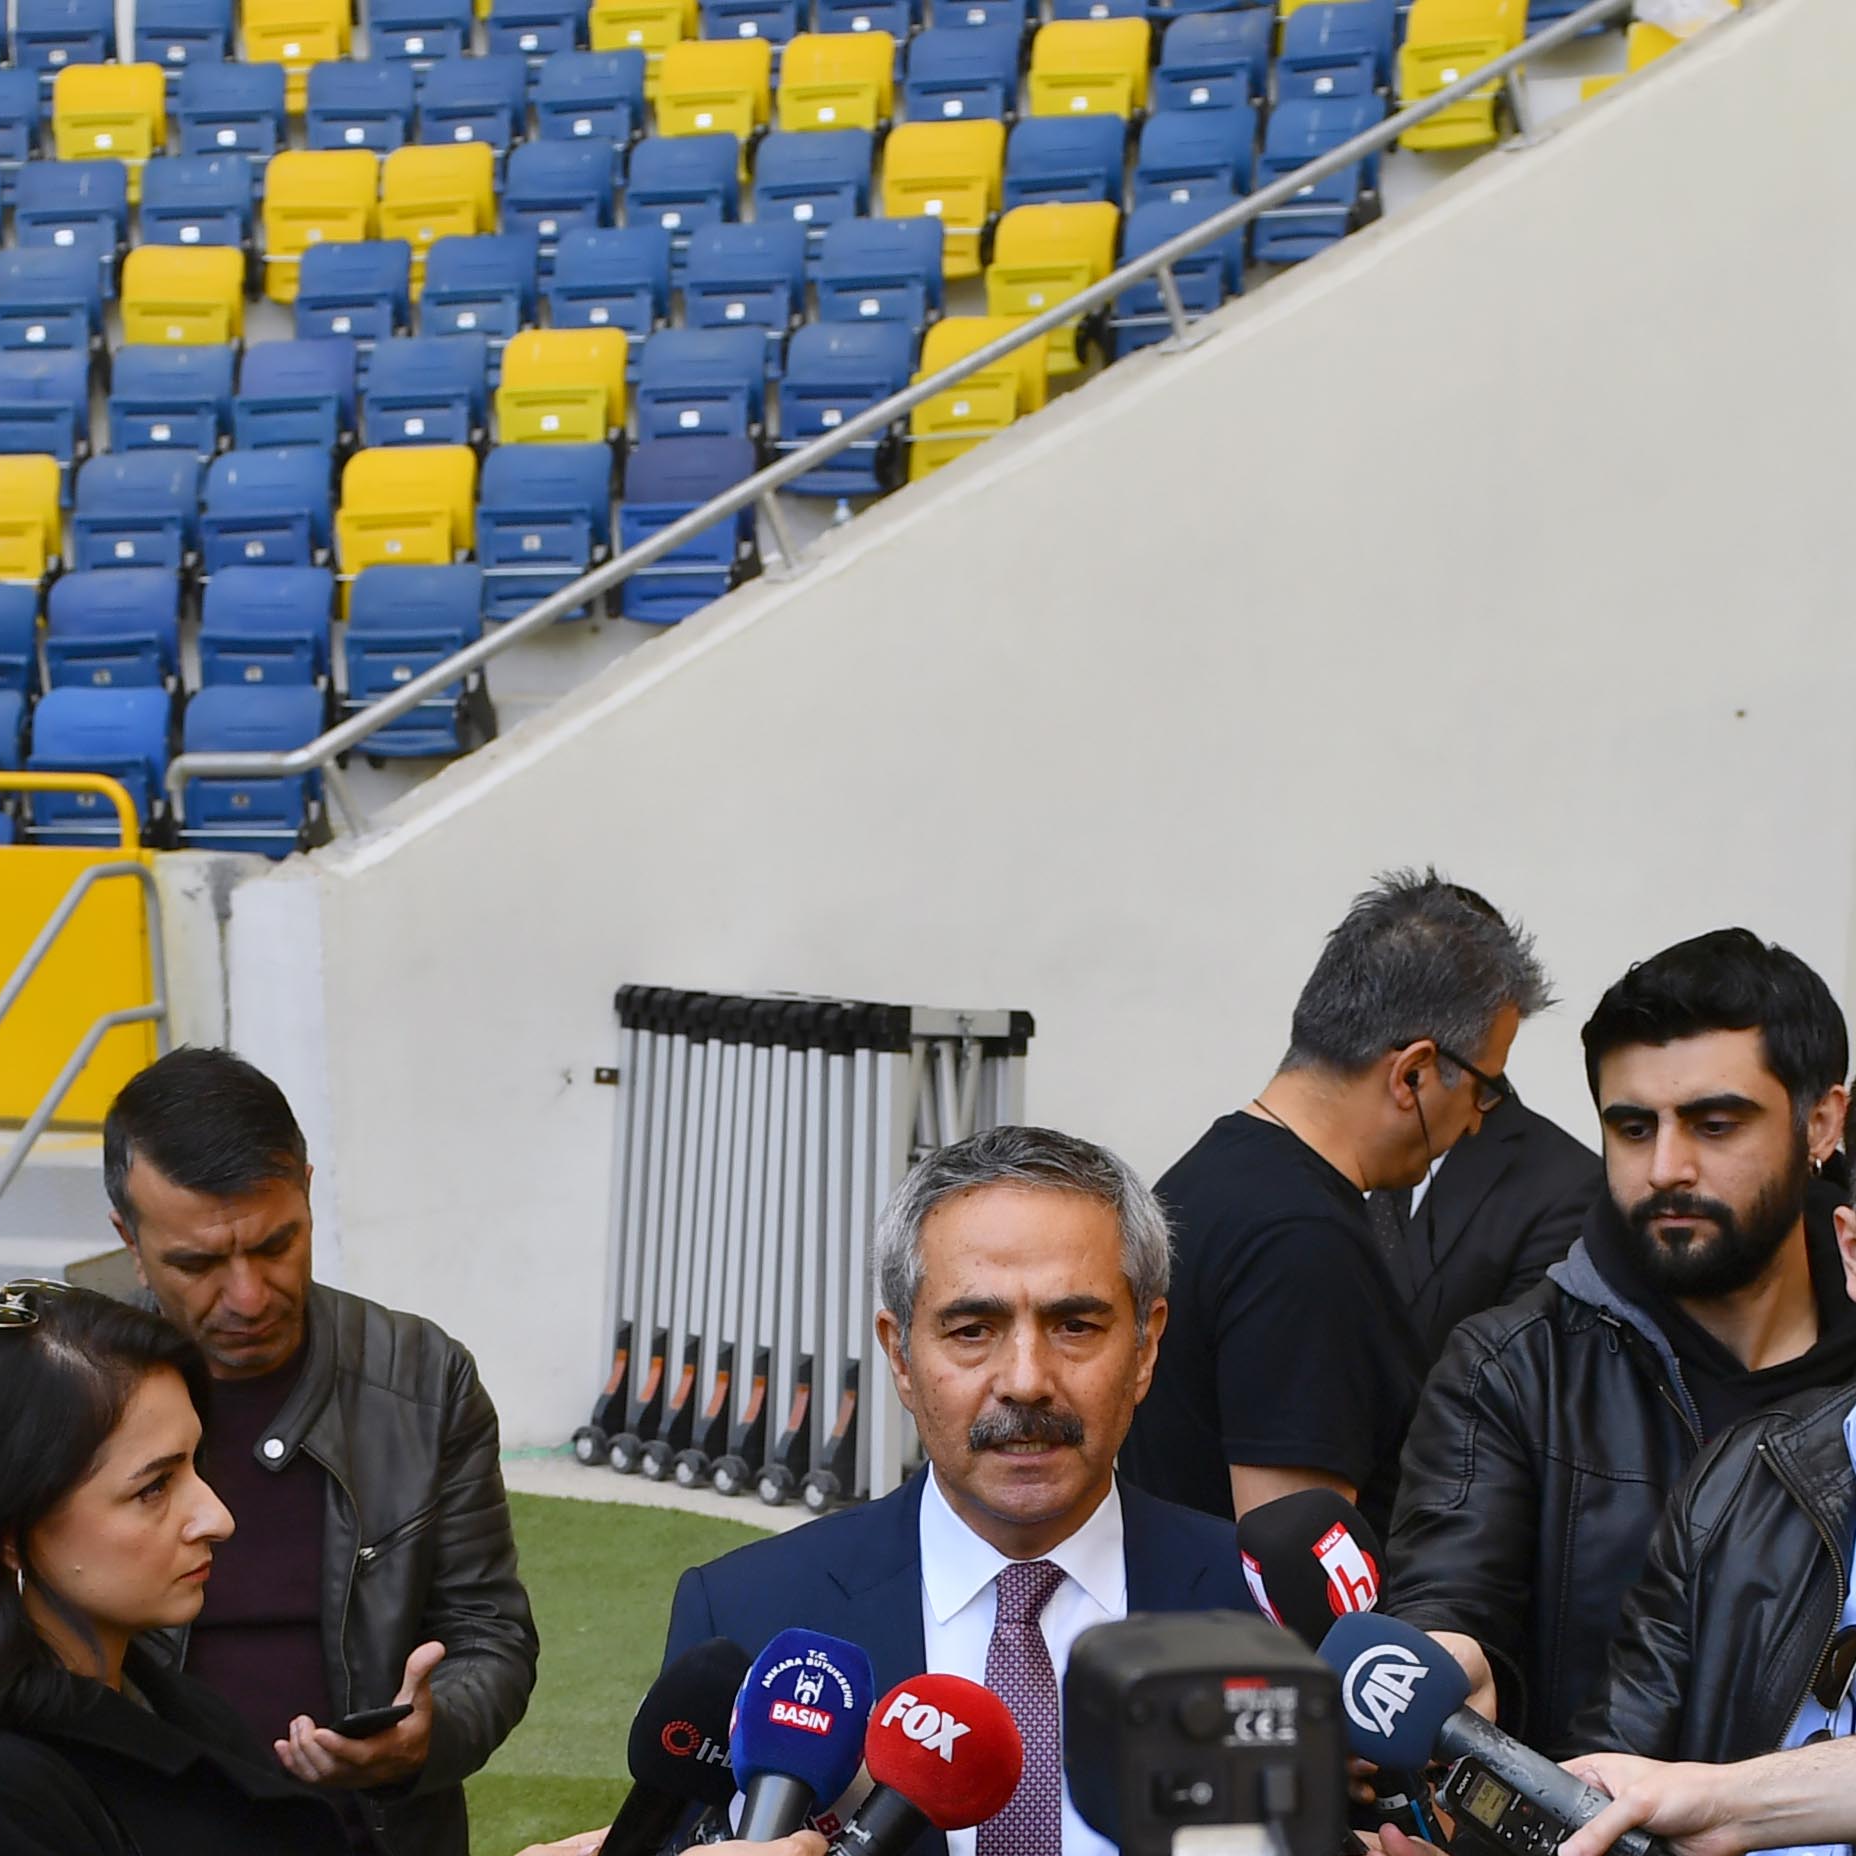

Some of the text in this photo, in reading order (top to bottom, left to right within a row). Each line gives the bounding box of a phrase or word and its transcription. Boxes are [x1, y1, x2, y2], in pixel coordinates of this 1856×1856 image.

[1319, 1529, 1341, 1553] HALK
[761, 1657, 803, 1689] ANKARA
[1360, 1663, 1430, 1738] AA
[772, 1704, 830, 1731] BASIN
[880, 1691, 972, 1763] FOX
[1456, 1770, 1472, 1795] SONY
